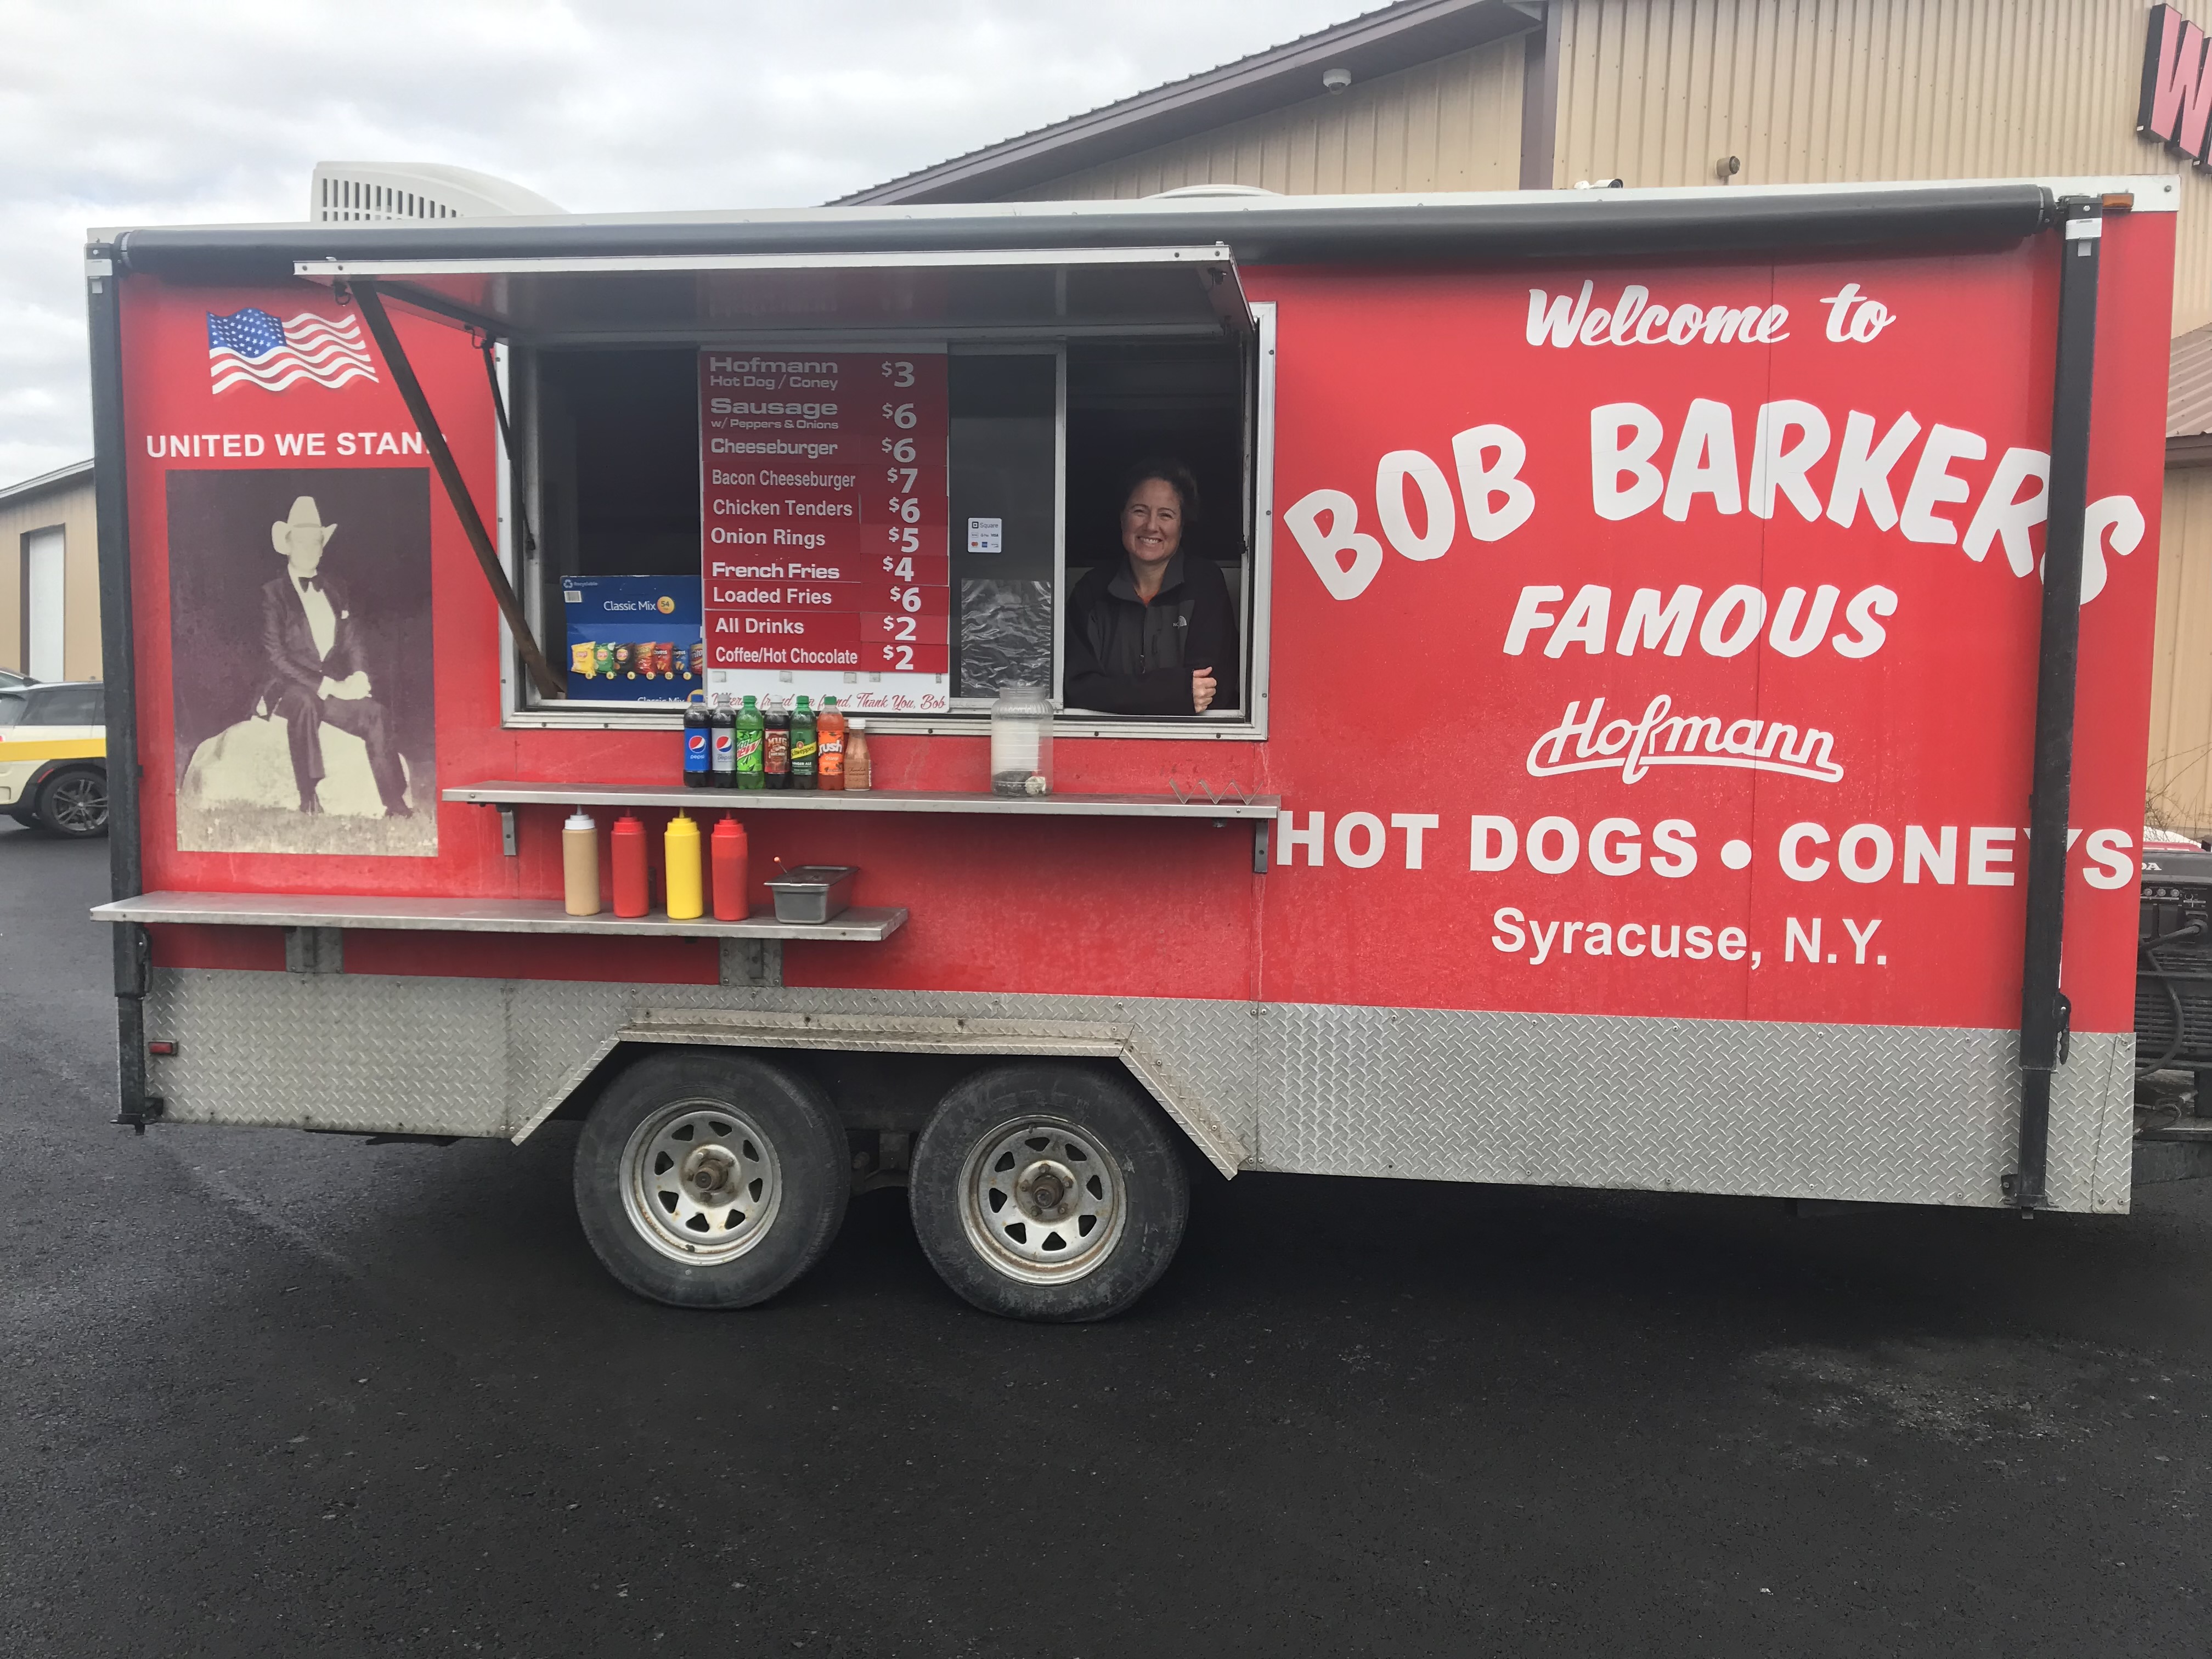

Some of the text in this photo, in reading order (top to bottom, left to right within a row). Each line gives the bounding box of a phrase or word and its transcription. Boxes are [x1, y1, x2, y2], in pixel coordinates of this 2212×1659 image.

[1526, 279, 1897, 348] Welcome to
[709, 357, 916, 387] Hofmann $3
[710, 375, 740, 387] Hot
[743, 376, 775, 390] Dog
[789, 376, 838, 391] Coney
[710, 398, 917, 429] Sausage $6
[711, 417, 839, 430] w/ Peppers & Onions
[146, 431, 447, 458] UNITED WE STAN
[710, 437, 917, 463] Cheeseburger $6
[712, 466, 918, 494] Bacon Cheeseburger $7
[713, 496, 921, 524] Chicken Tenders $6
[1284, 424, 1536, 601] BOB
[711, 526, 920, 553] Onion Rings $5
[712, 555, 915, 582] French Fries $4
[603, 601, 656, 611] Classic Mix
[713, 585, 921, 612] Loaded Fries $6
[715, 615, 917, 641] All Drinks $2
[1502, 584, 1898, 659] FAMOUS
[715, 645, 914, 670] Coffee/Hot Chocolate $2
[856, 692, 888, 709] Thank
[892, 694, 916, 711] You,
[921, 694, 946, 710] Bob
[818, 740, 843, 756] rush
[1527, 695, 1844, 785] Hofmann
[1277, 810, 1438, 869] HOT
[1470, 815, 1698, 878] DOGS
[1491, 907, 1887, 970] Syracuse, N.Y.
